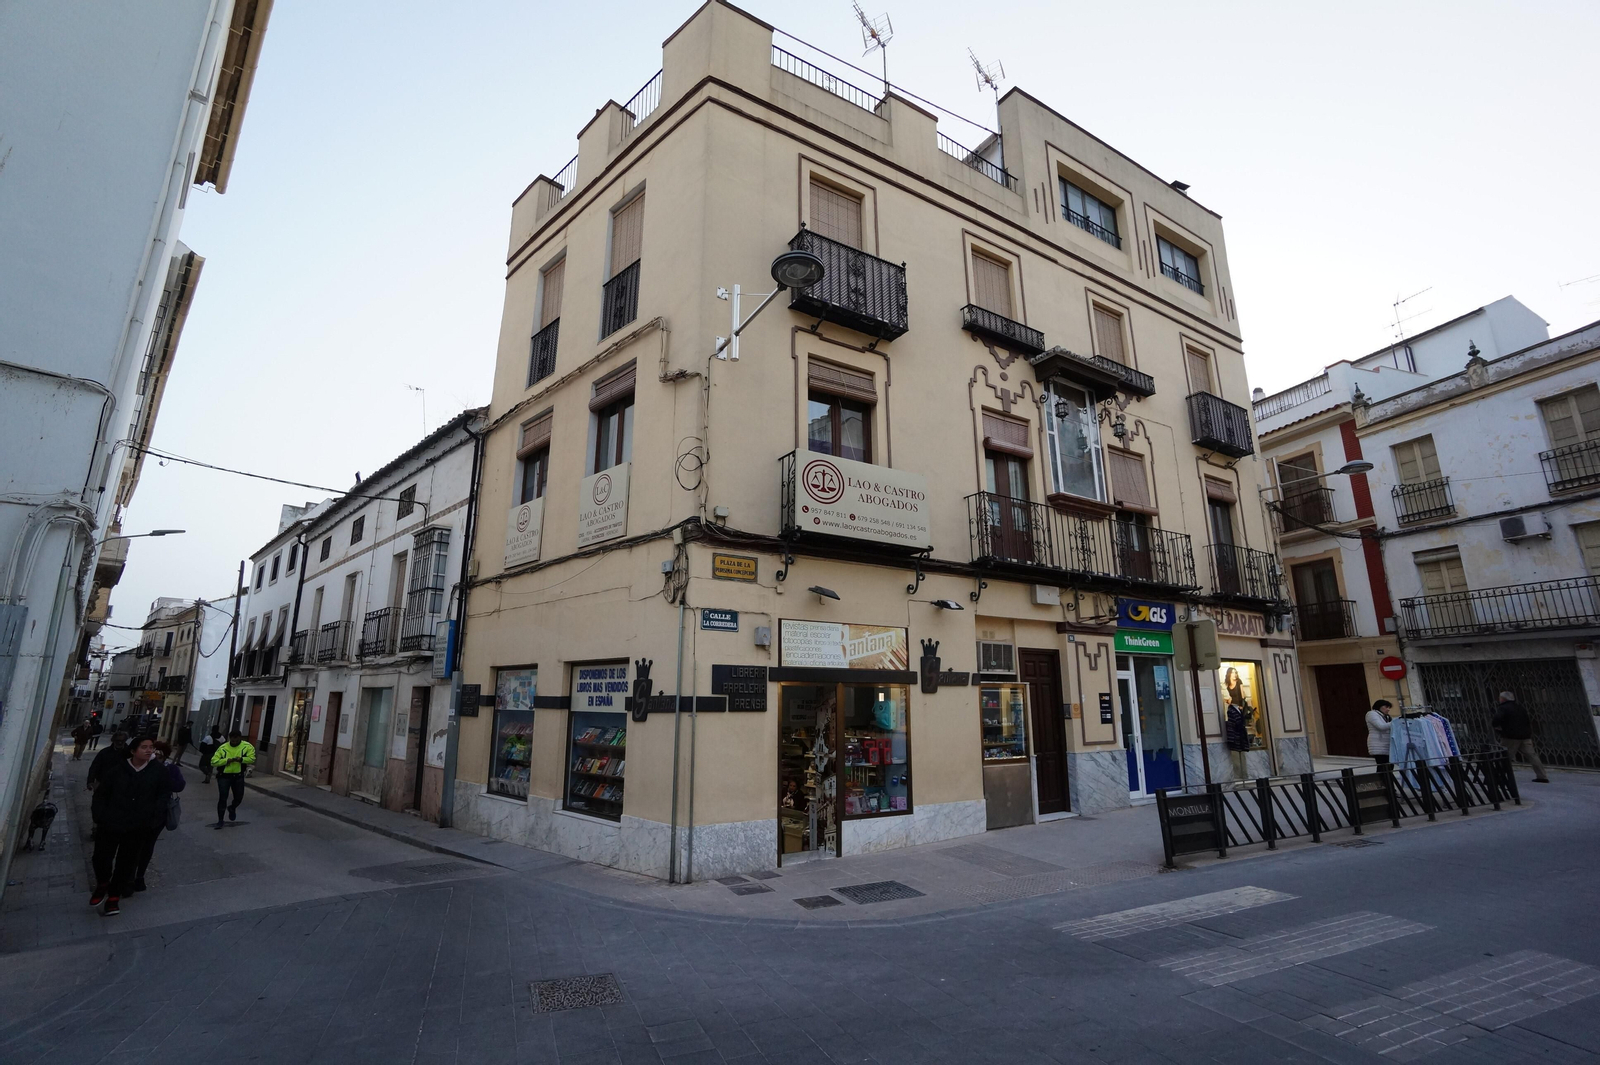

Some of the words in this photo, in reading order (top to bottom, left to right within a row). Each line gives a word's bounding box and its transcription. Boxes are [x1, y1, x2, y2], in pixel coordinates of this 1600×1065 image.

[848, 477, 871, 490] LAO
[874, 482, 881, 493] &
[884, 485, 925, 501] CASTRO
[858, 493, 919, 513] ABOGADOS
[580, 510, 592, 522] LAO
[598, 500, 624, 515] CASTRO
[586, 512, 616, 528] ABOGADOS
[822, 520, 917, 540] www.laoycastroabogados.es
[1150, 607, 1167, 623] GLS
[783, 622, 808, 630] revistas
[1124, 636, 1160, 647] ThinkGreen
[579, 669, 607, 680] DISPONEMOS
[609, 668, 615, 679] DE
[617, 668, 626, 679] LOS
[577, 683, 592, 693] LIBROS
[593, 682, 603, 693] MAS
[605, 681, 628, 693] VENDIDOS
[588, 696, 594, 706] EN
[595, 693, 613, 706] ESPAÑA
[735, 699, 766, 709] PRENSA
[1168, 805, 1210, 817] MONTILLA
